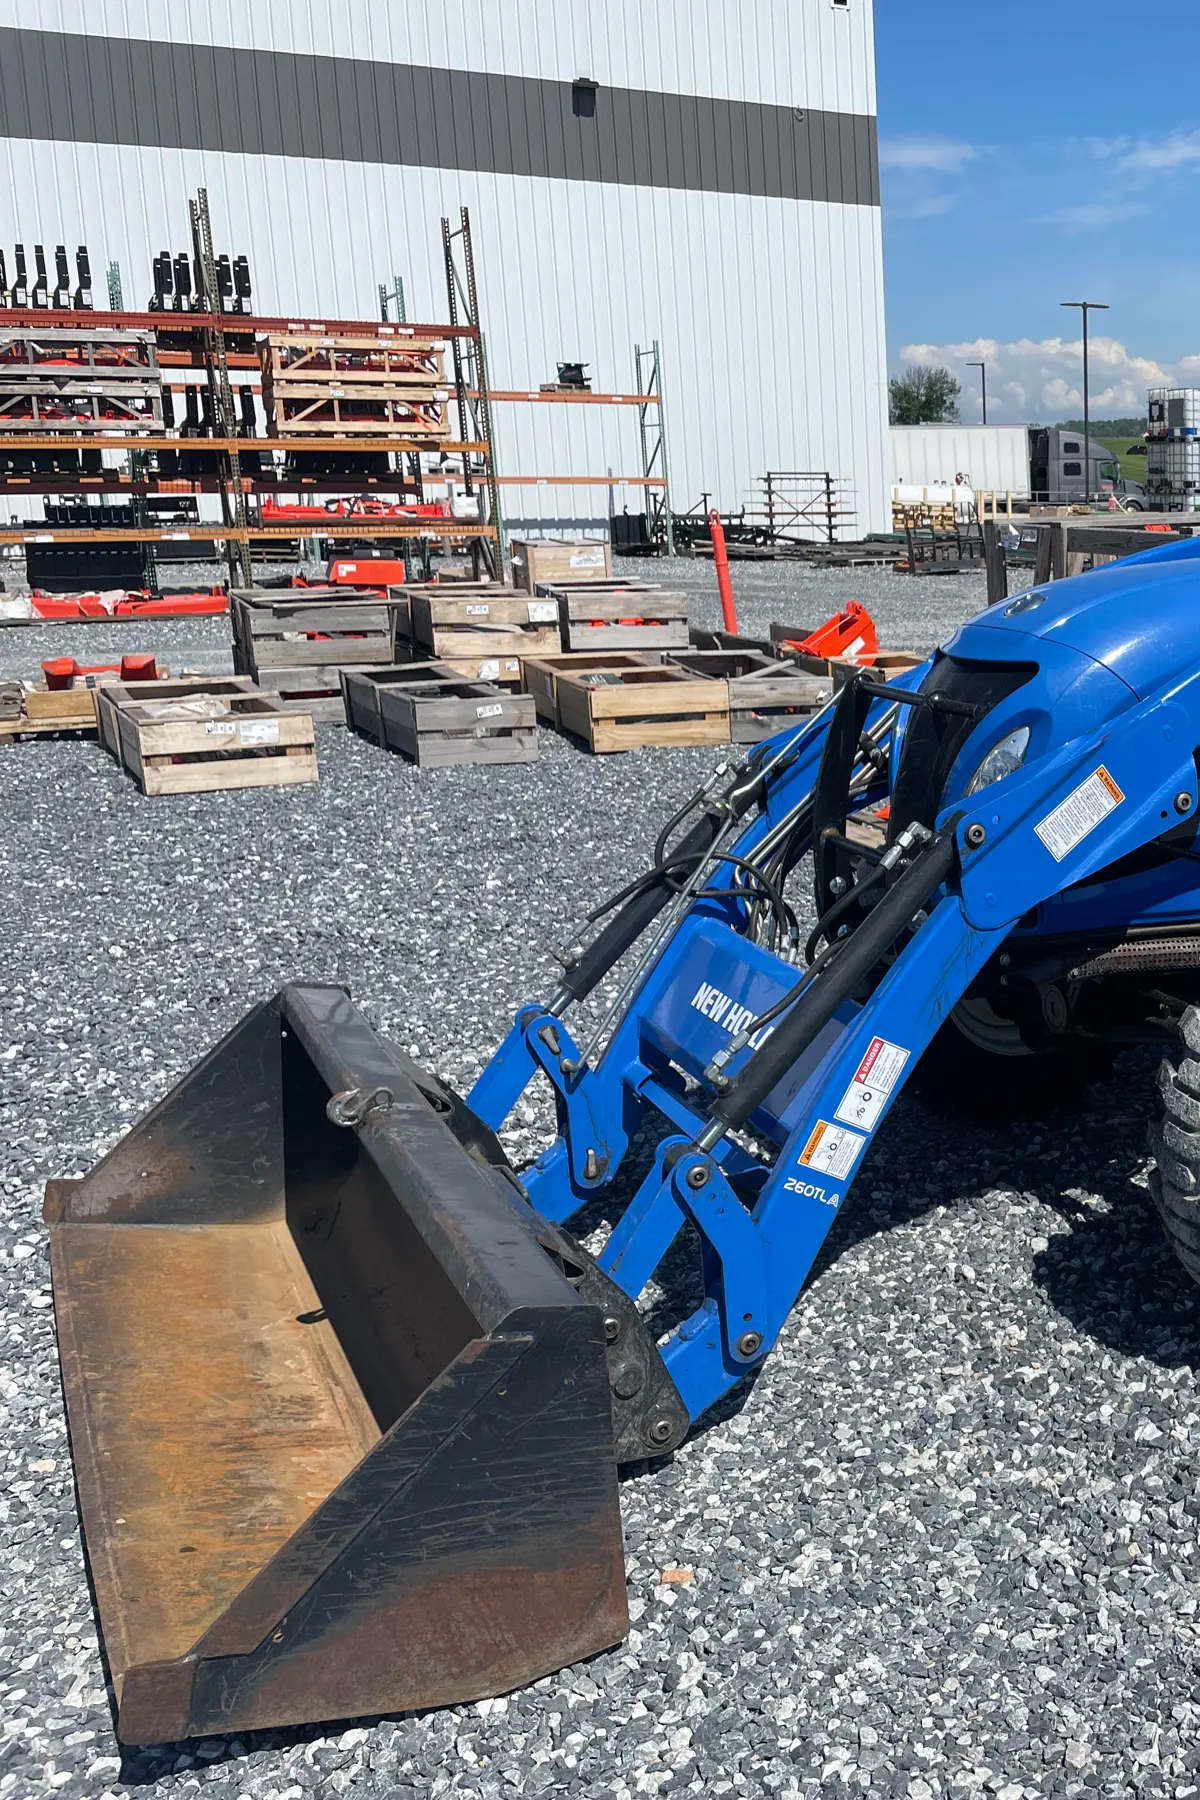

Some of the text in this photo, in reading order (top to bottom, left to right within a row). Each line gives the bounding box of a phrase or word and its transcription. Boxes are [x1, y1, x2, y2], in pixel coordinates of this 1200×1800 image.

[690, 981, 733, 1023] NEW
[862, 1042, 881, 1073] DANGER
[808, 1126, 824, 1154] WARNING
[783, 1177, 840, 1208] 260TLA
